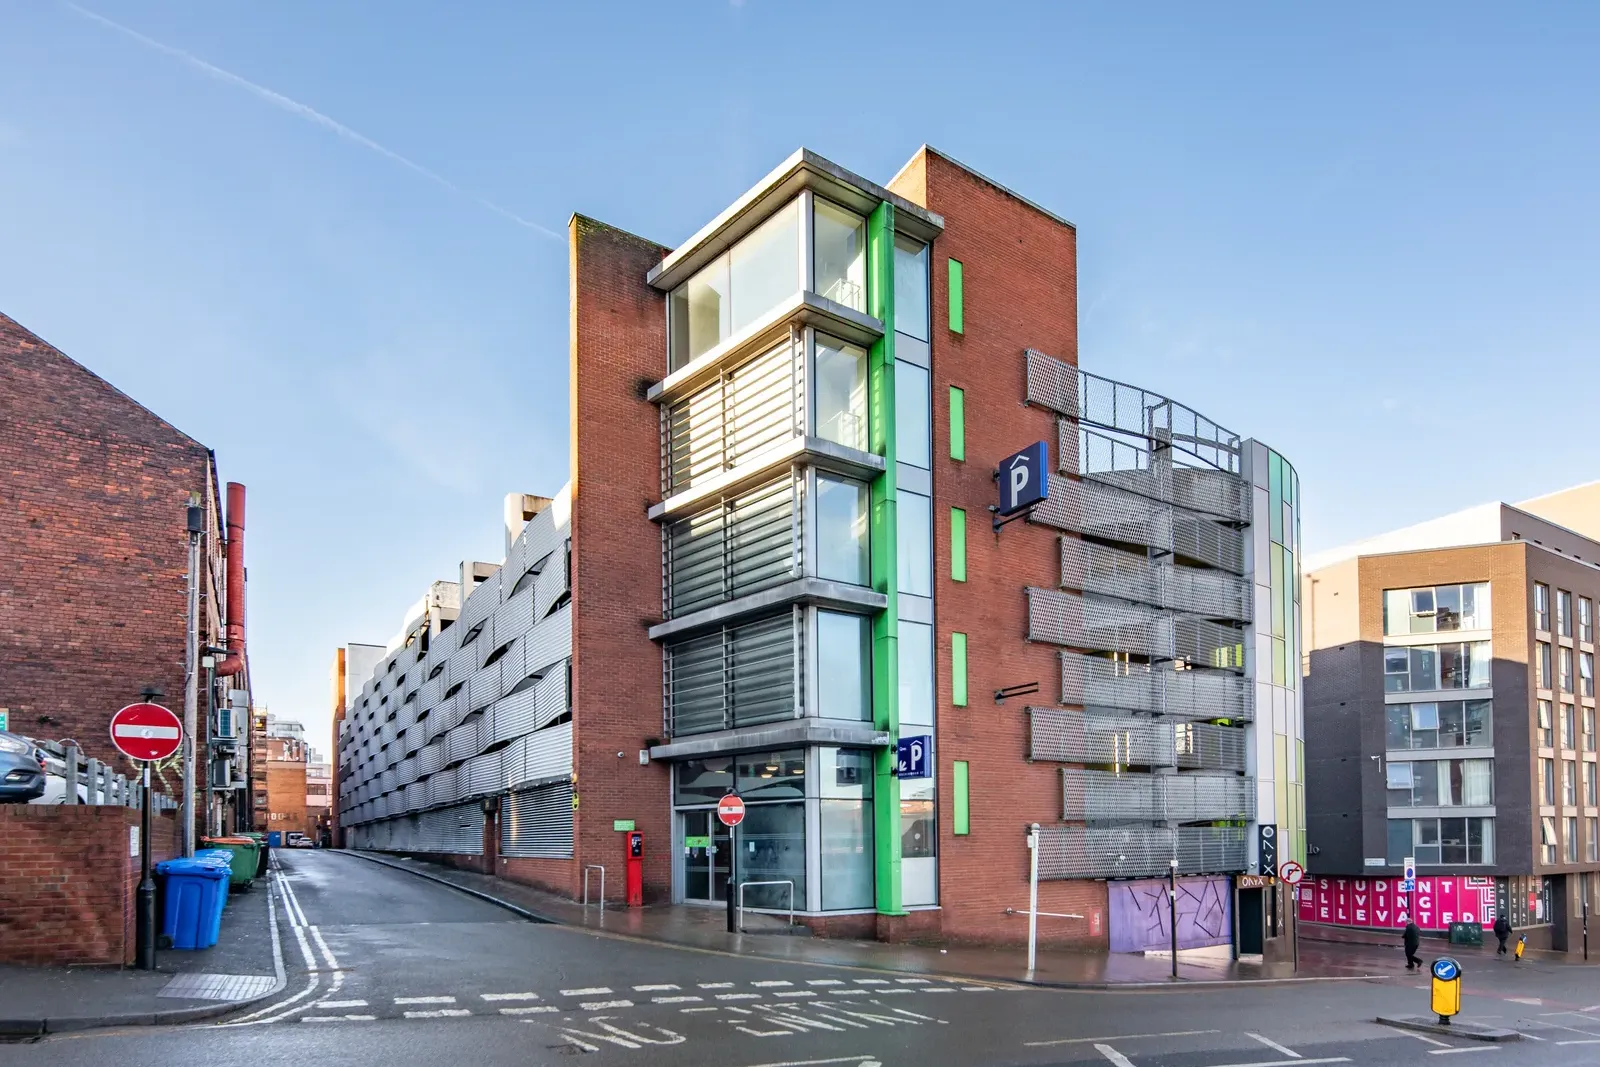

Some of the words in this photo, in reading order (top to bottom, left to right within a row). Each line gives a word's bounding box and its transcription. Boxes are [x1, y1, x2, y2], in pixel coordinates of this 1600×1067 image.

[1262, 826, 1275, 875] ONYX
[1242, 877, 1264, 887] ONYX
[1320, 879, 1453, 893] STUDENT
[1320, 892, 1432, 908] LIVING
[1320, 906, 1474, 924] ELEVATED
